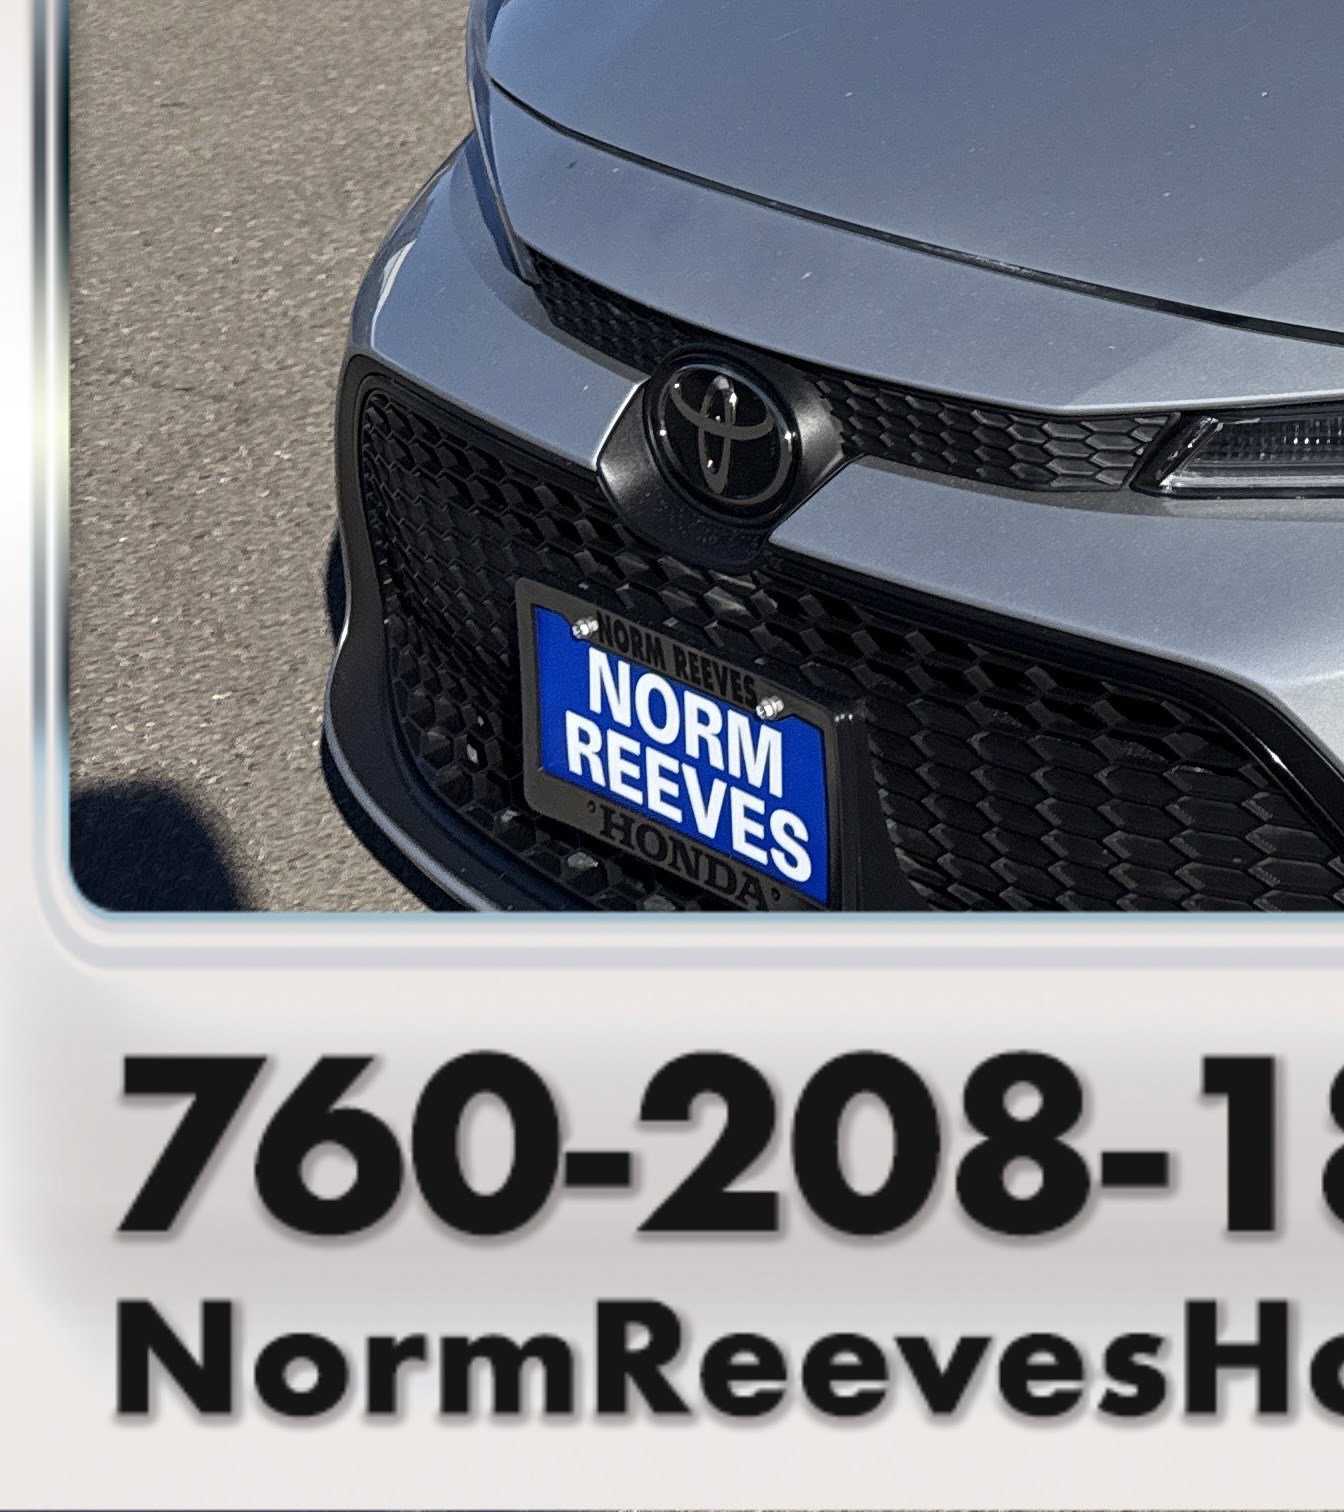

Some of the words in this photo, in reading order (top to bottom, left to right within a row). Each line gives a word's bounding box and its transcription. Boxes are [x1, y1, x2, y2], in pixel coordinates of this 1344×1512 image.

[588, 646, 782, 799] NORM
[596, 610, 667, 671] NORM
[672, 642, 757, 708] REEVES
[565, 710, 812, 882] REEVES
